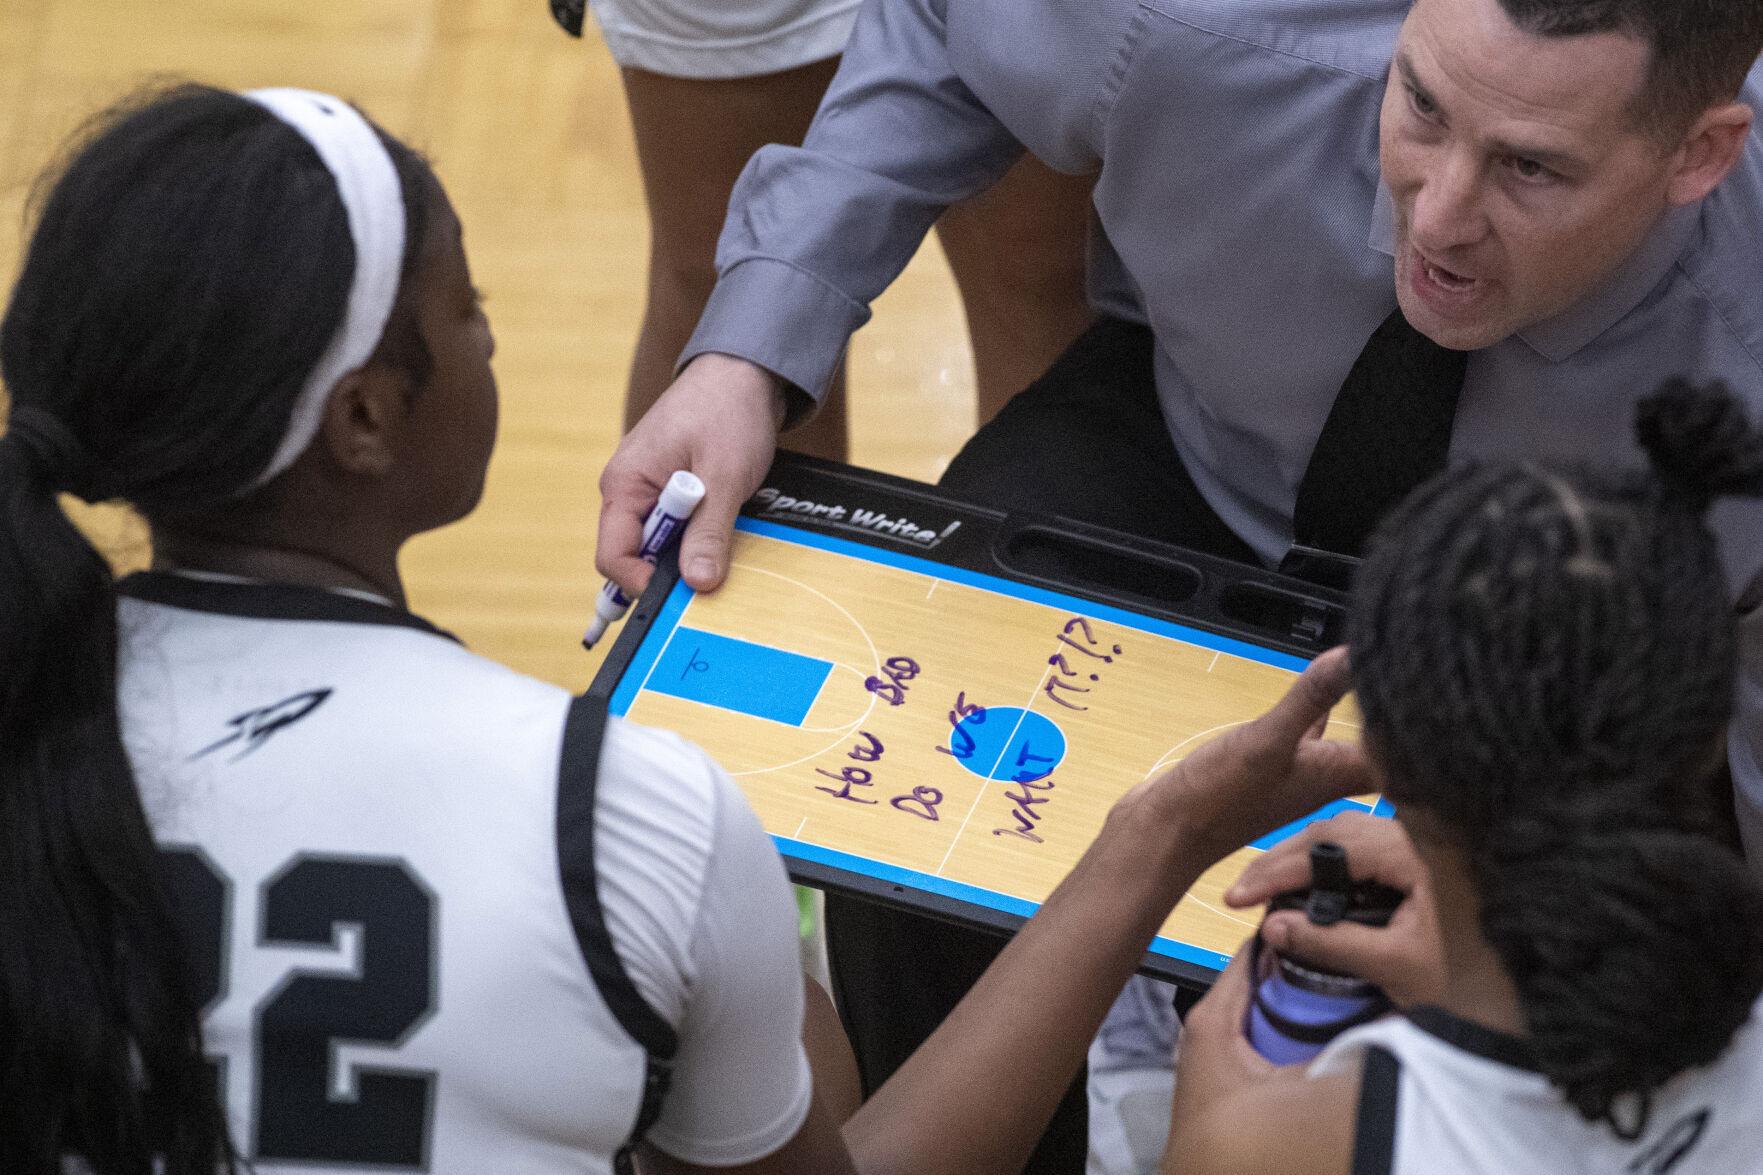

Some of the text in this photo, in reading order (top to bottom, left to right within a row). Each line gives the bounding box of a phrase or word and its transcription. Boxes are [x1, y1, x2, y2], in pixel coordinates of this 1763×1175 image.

[756, 487, 962, 544] Sport Write!
[935, 690, 987, 760] WE
[815, 731, 885, 805] HOW
[992, 739, 1056, 844] WANT
